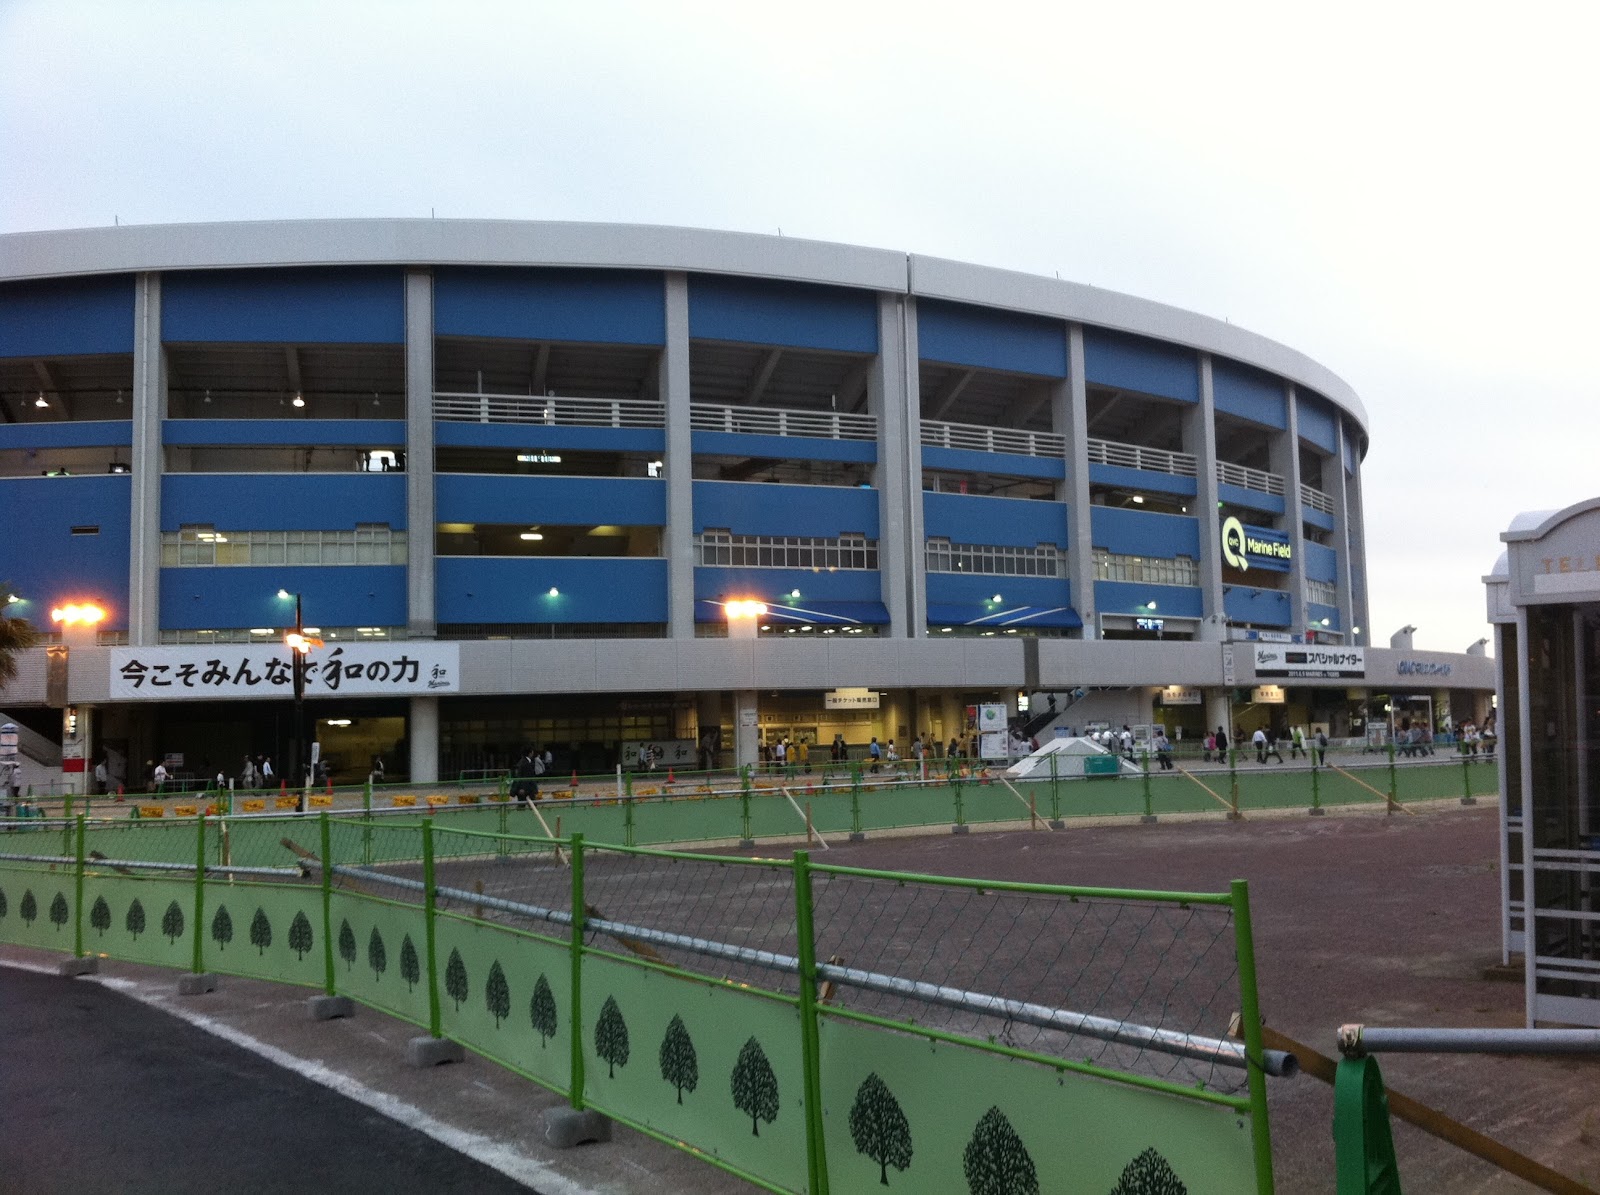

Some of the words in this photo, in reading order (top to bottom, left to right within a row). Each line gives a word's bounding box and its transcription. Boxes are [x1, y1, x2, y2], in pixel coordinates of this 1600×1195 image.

[1247, 538, 1273, 556] Marine
[1273, 542, 1291, 558] Field
[1308, 652, 1362, 665] スペシャルナイター
[120, 647, 419, 690] 今こそみんなで和の力
[431, 663, 447, 679] 和
